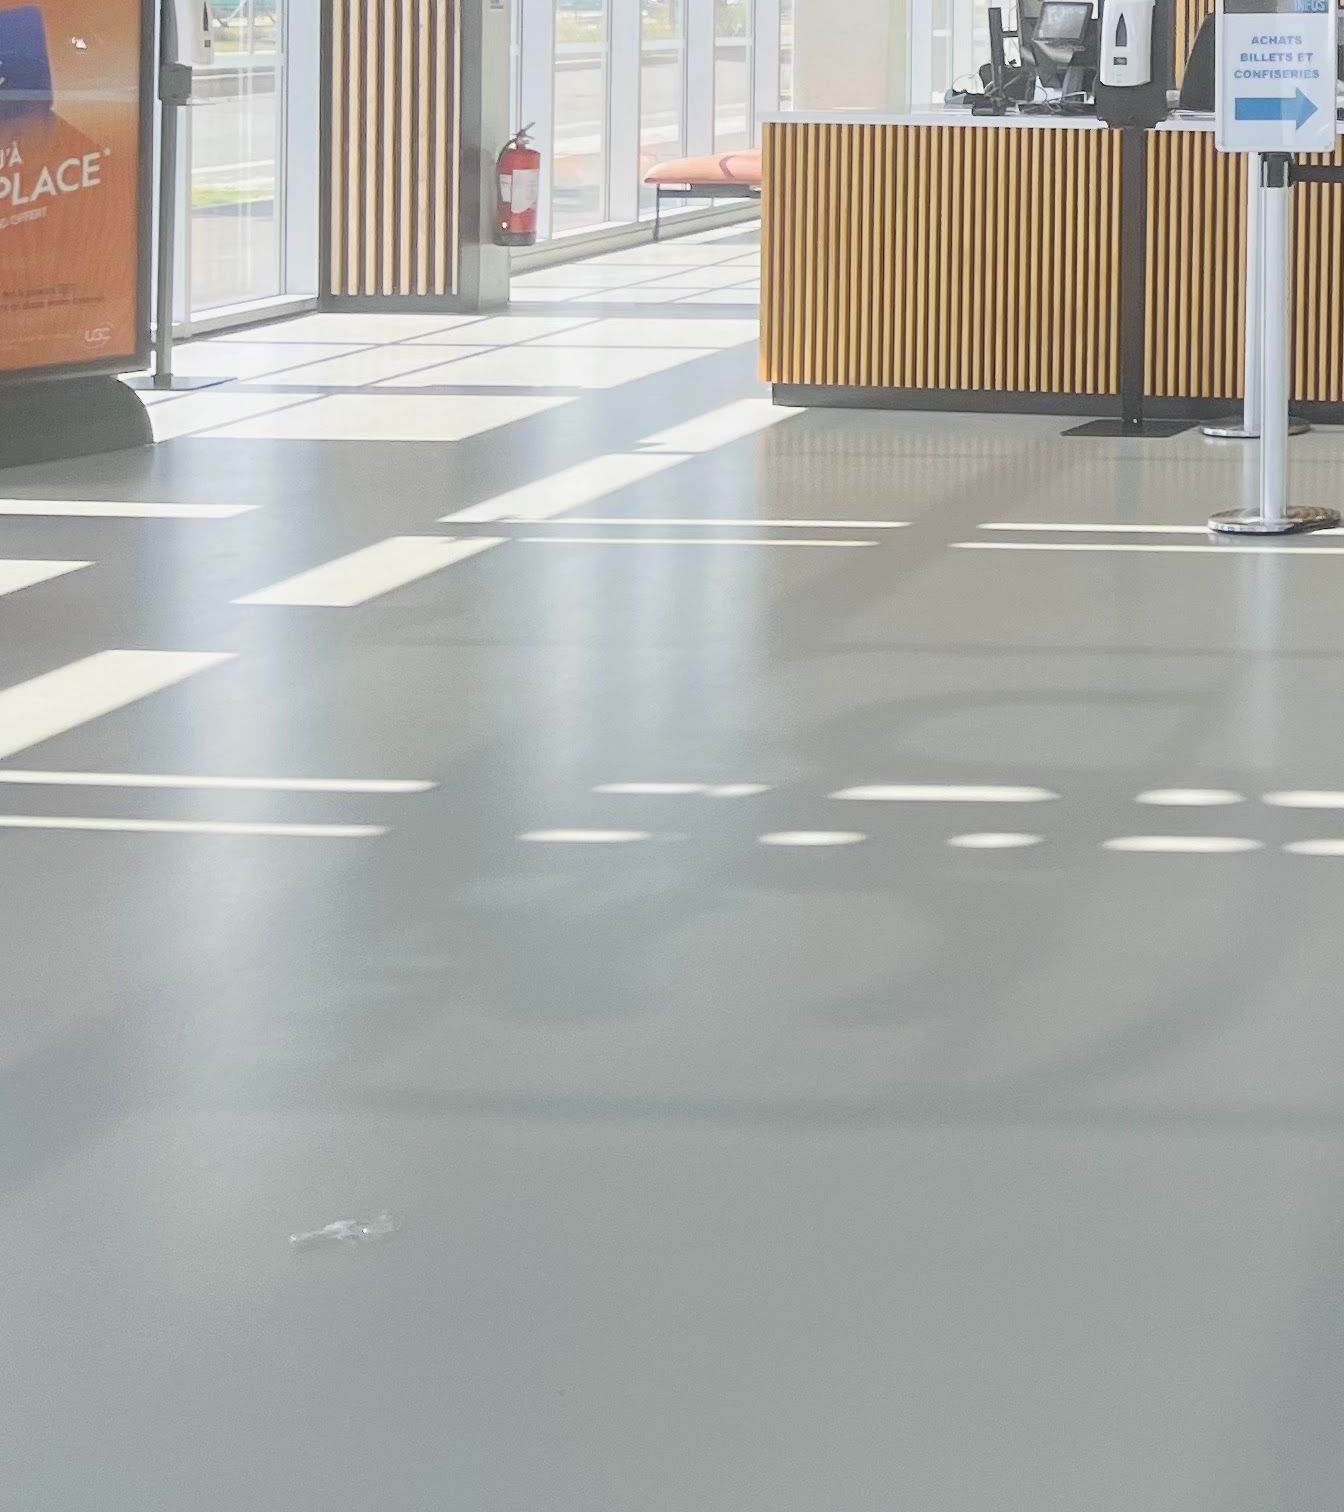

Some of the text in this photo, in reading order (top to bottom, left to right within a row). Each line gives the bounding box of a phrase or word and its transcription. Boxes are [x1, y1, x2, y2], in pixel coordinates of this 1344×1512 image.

[1251, 36, 1303, 45] ACHATS
[1240, 53, 1314, 63] BILLETS ET
[1234, 69, 1320, 79] CONFISERIES
